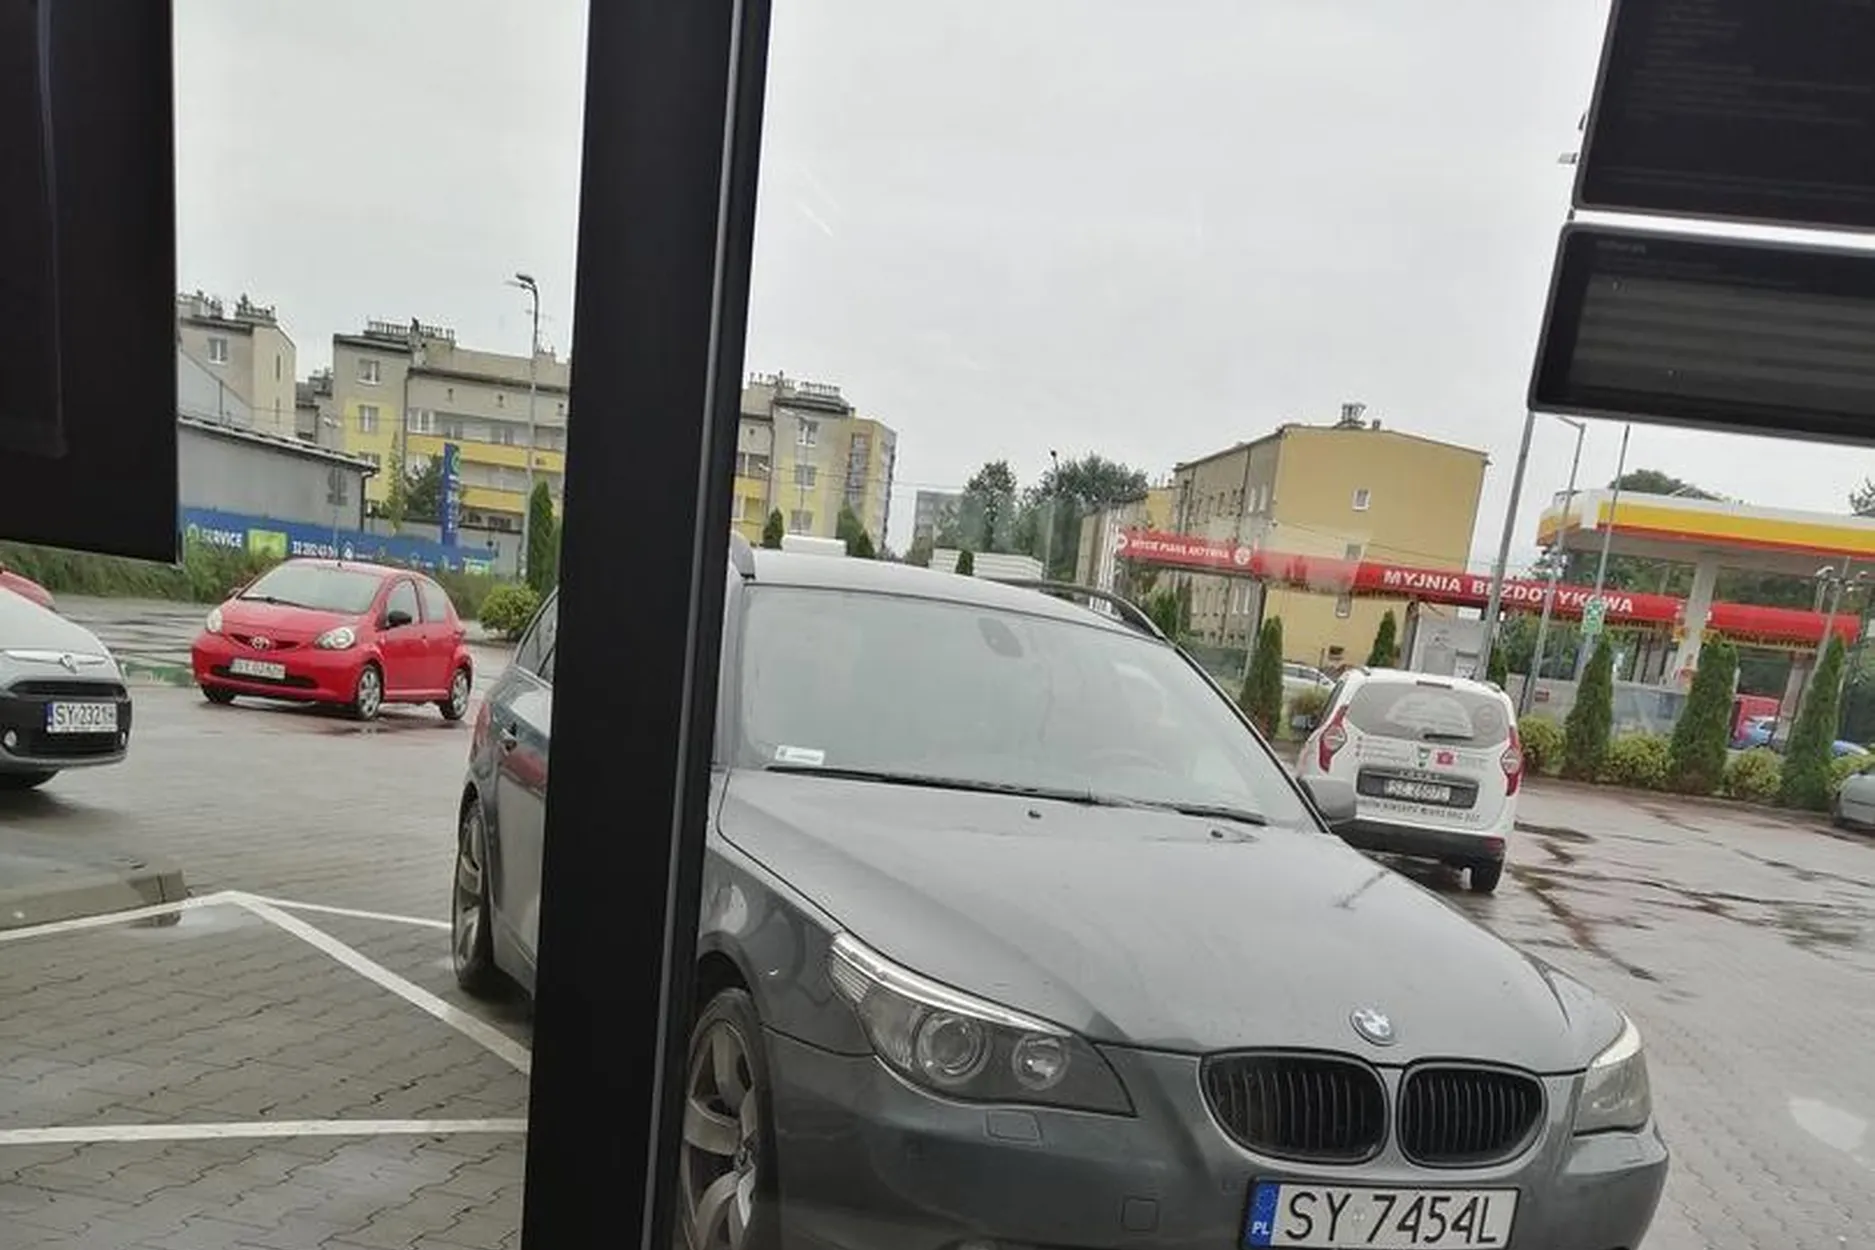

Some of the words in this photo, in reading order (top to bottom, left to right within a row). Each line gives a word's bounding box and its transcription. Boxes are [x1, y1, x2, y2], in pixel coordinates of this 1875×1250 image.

[1383, 569, 1461, 594] MYJNIA
[1471, 580, 1634, 613] BEZDOYKWA
[1251, 1221, 1270, 1235] PL
[1285, 1191, 1352, 1242] SY
[1366, 1194, 1497, 1244] 7454L
